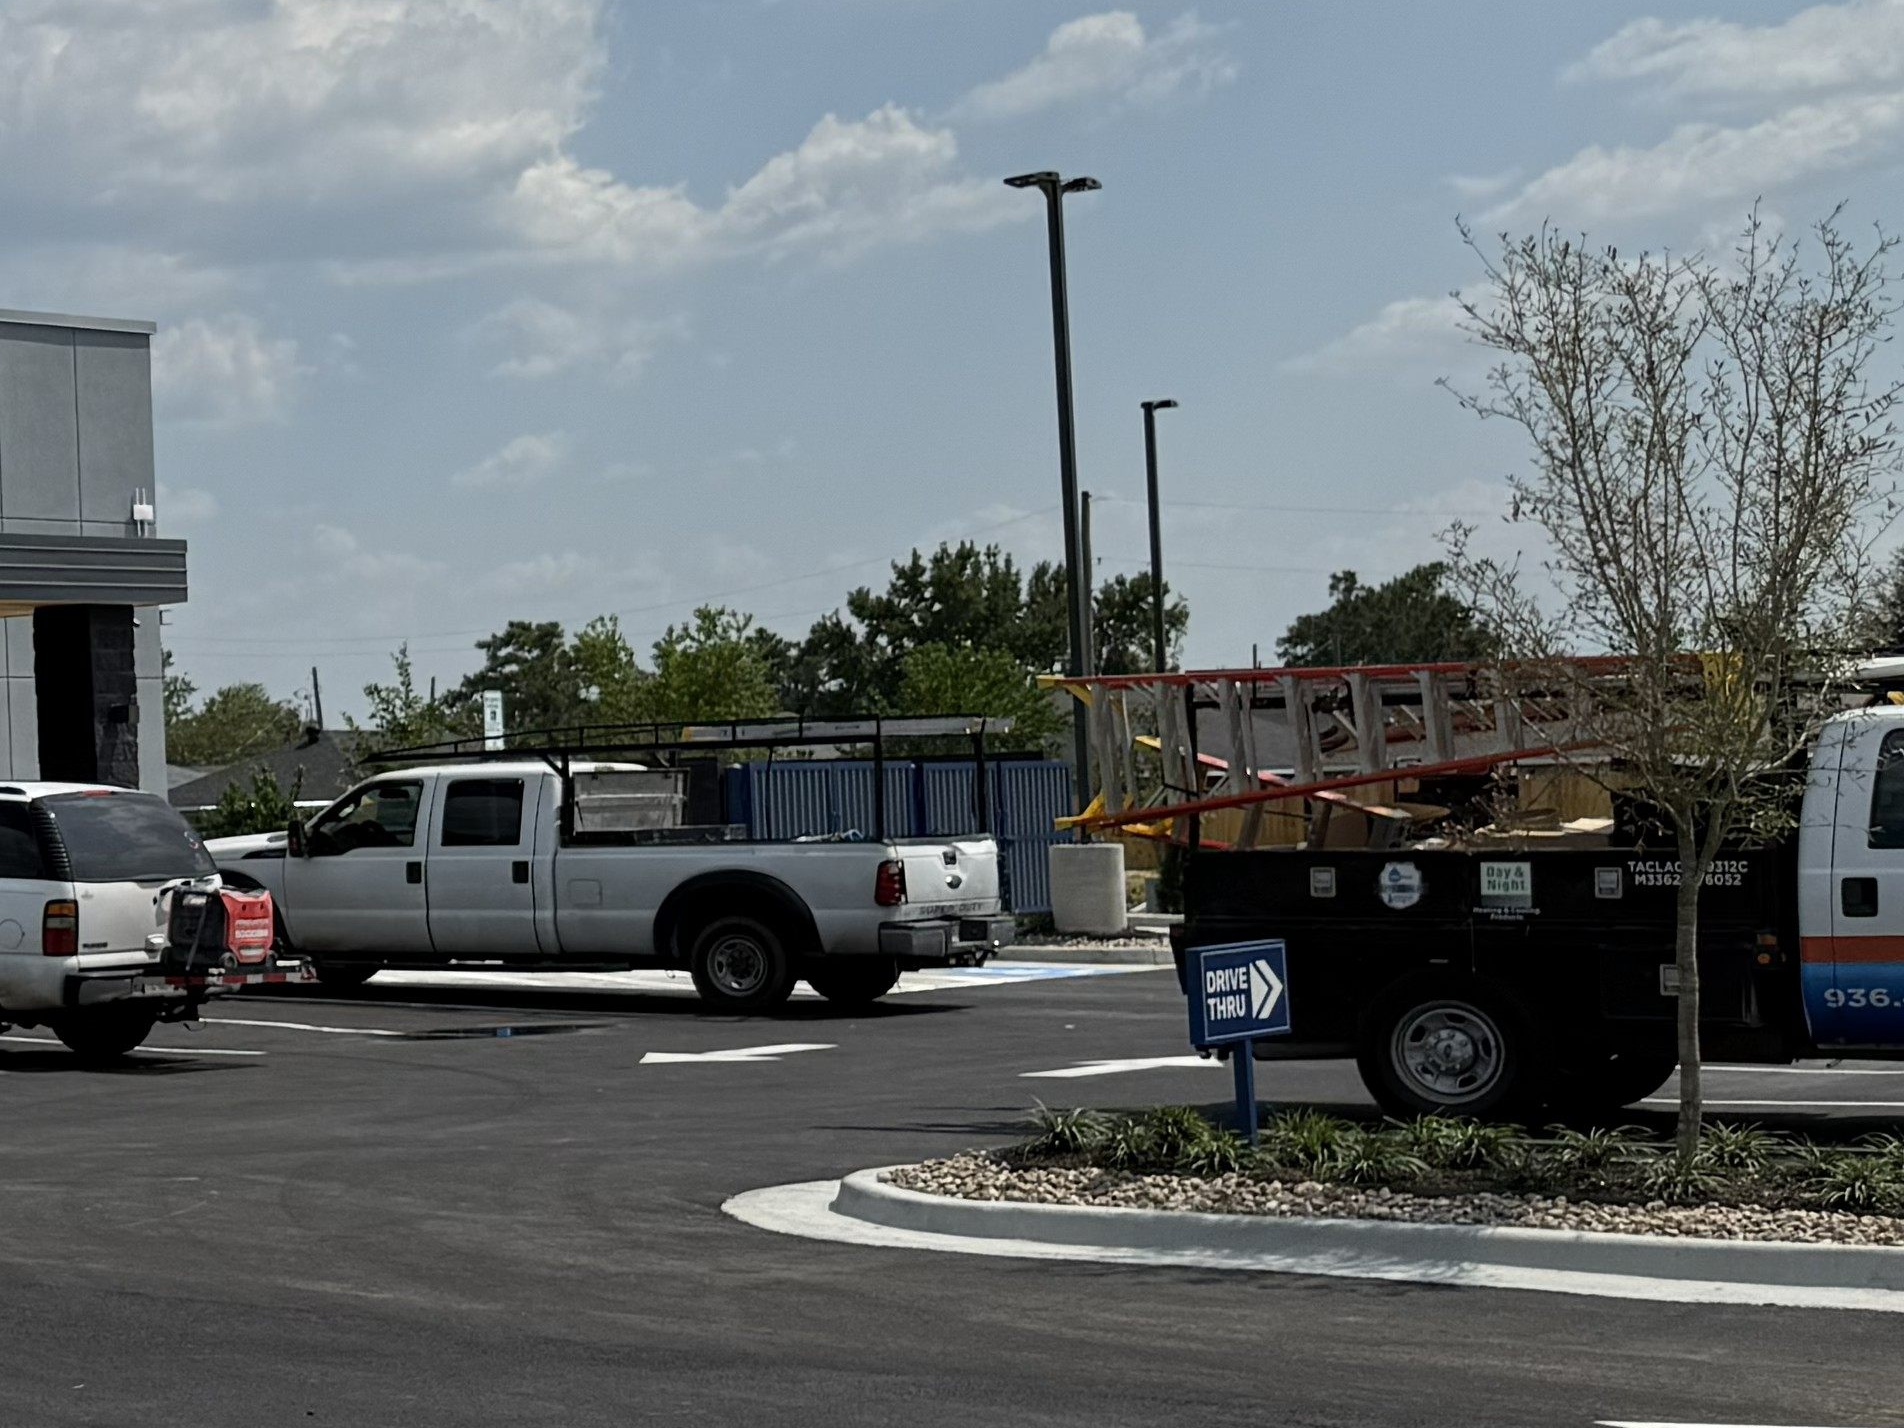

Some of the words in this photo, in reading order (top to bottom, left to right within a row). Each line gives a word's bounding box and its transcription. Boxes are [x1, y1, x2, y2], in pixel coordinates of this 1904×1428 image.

[1486, 866, 1511, 879] Day
[1514, 866, 1524, 877] &
[1486, 879, 1525, 892] Night
[1206, 967, 1248, 993] DRIVE
[1207, 994, 1246, 1021] THRU
[1823, 988, 1904, 1008] 936.
